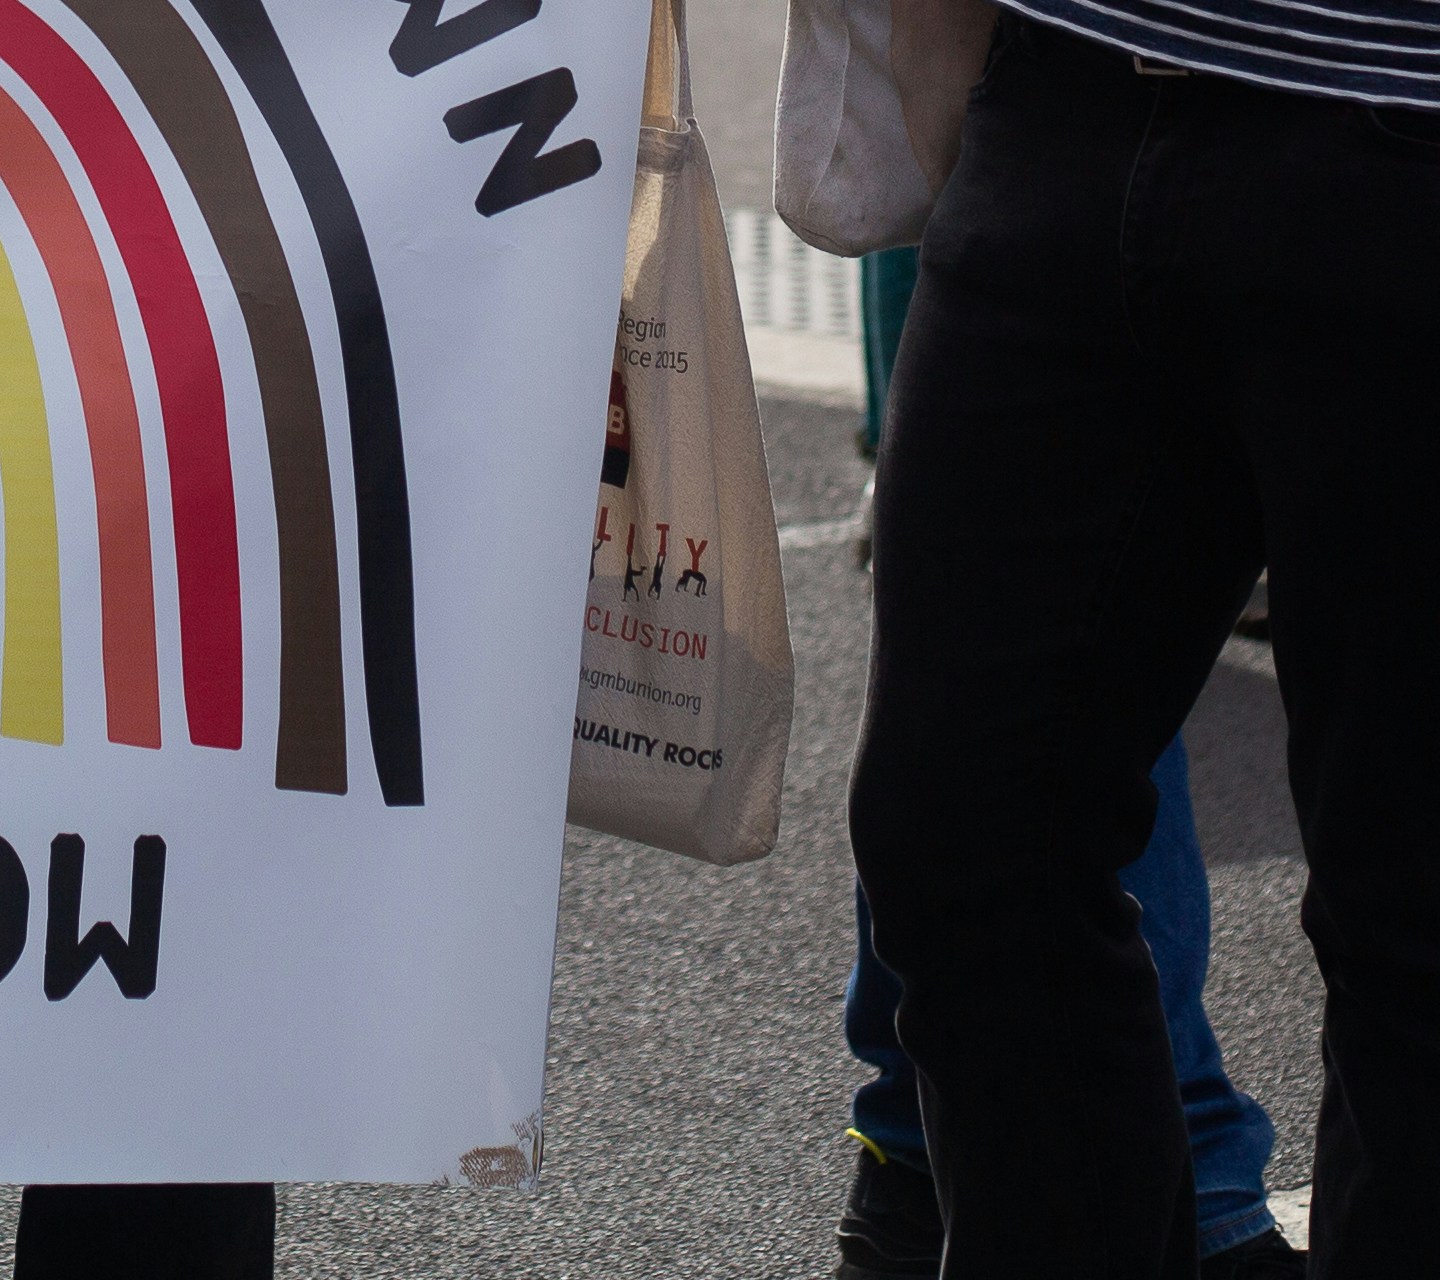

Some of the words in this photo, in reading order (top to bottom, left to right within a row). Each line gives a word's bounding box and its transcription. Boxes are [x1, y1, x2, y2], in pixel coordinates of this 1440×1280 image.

[620, 346, 652, 368] nce
[655, 350, 689, 374] 2015
[596, 506, 709, 573] LITY
[583, 606, 708, 660] CLUSION
[579, 665, 703, 716] w.gmbunion.org
[573, 716, 660, 758] UALITY
